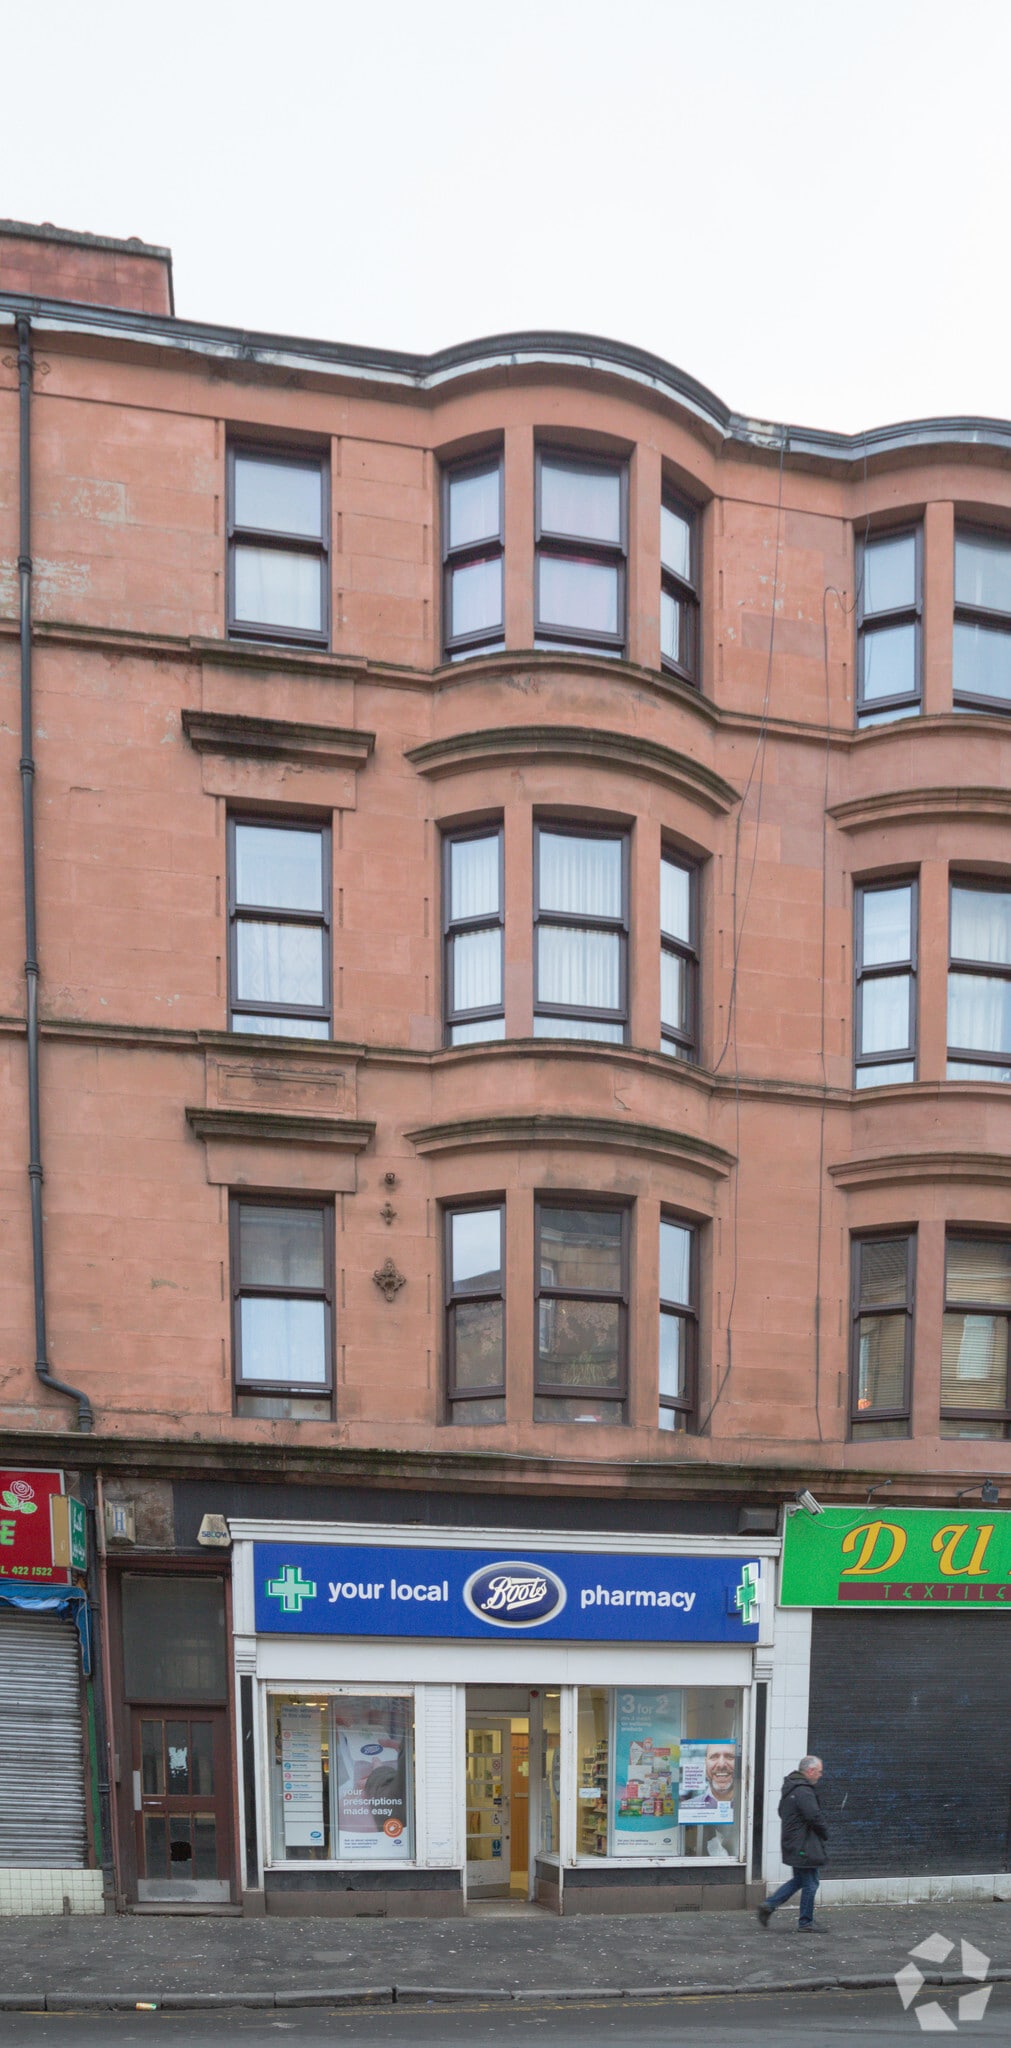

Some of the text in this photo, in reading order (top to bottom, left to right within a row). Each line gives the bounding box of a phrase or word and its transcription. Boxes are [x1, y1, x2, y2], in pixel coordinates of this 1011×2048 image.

[840, 1520, 1011, 1576] DU
[12, 1566, 29, 1576] 422
[31, 1567, 53, 1577] 1522
[328, 1576, 697, 1612] your local Boots pharmacy
[882, 1584, 1007, 1600] TEXTILE
[622, 1694, 669, 1714] 3 for 2
[343, 1789, 363, 1797] your
[343, 1797, 403, 1807] prescriptions
[343, 1807, 393, 1817] made easy
